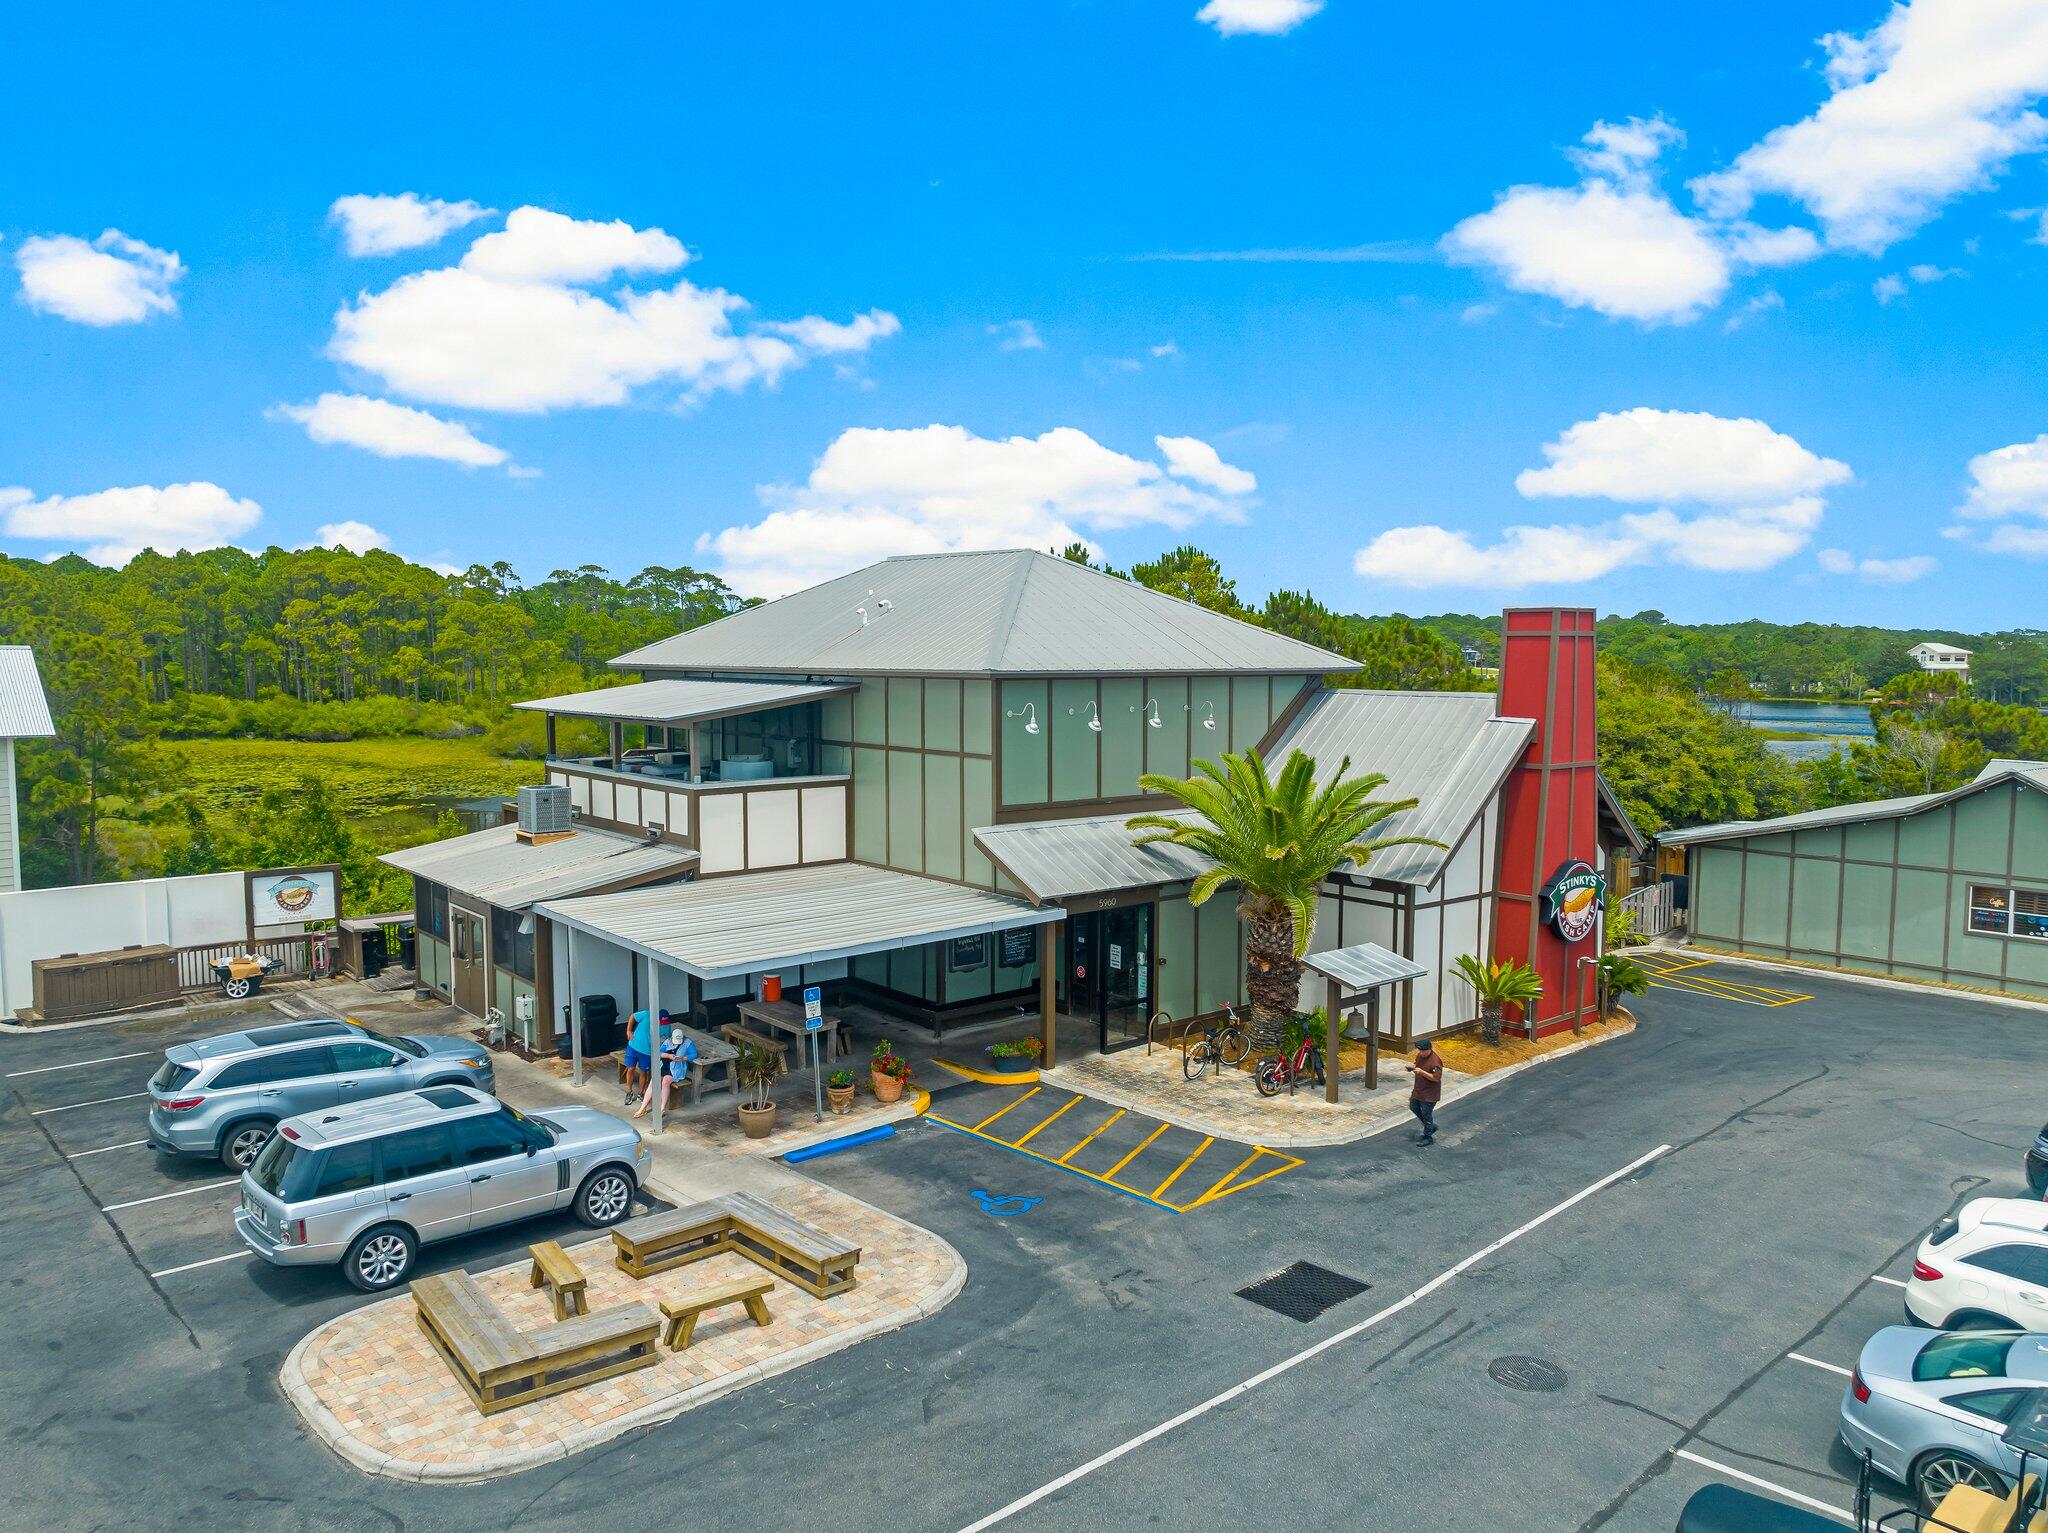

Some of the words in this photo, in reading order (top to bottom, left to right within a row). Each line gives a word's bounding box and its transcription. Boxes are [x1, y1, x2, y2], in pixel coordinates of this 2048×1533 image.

[1559, 875, 1597, 894] STINKY'S
[1099, 898, 1117, 908] 5960
[1576, 905, 1595, 935] CAMP
